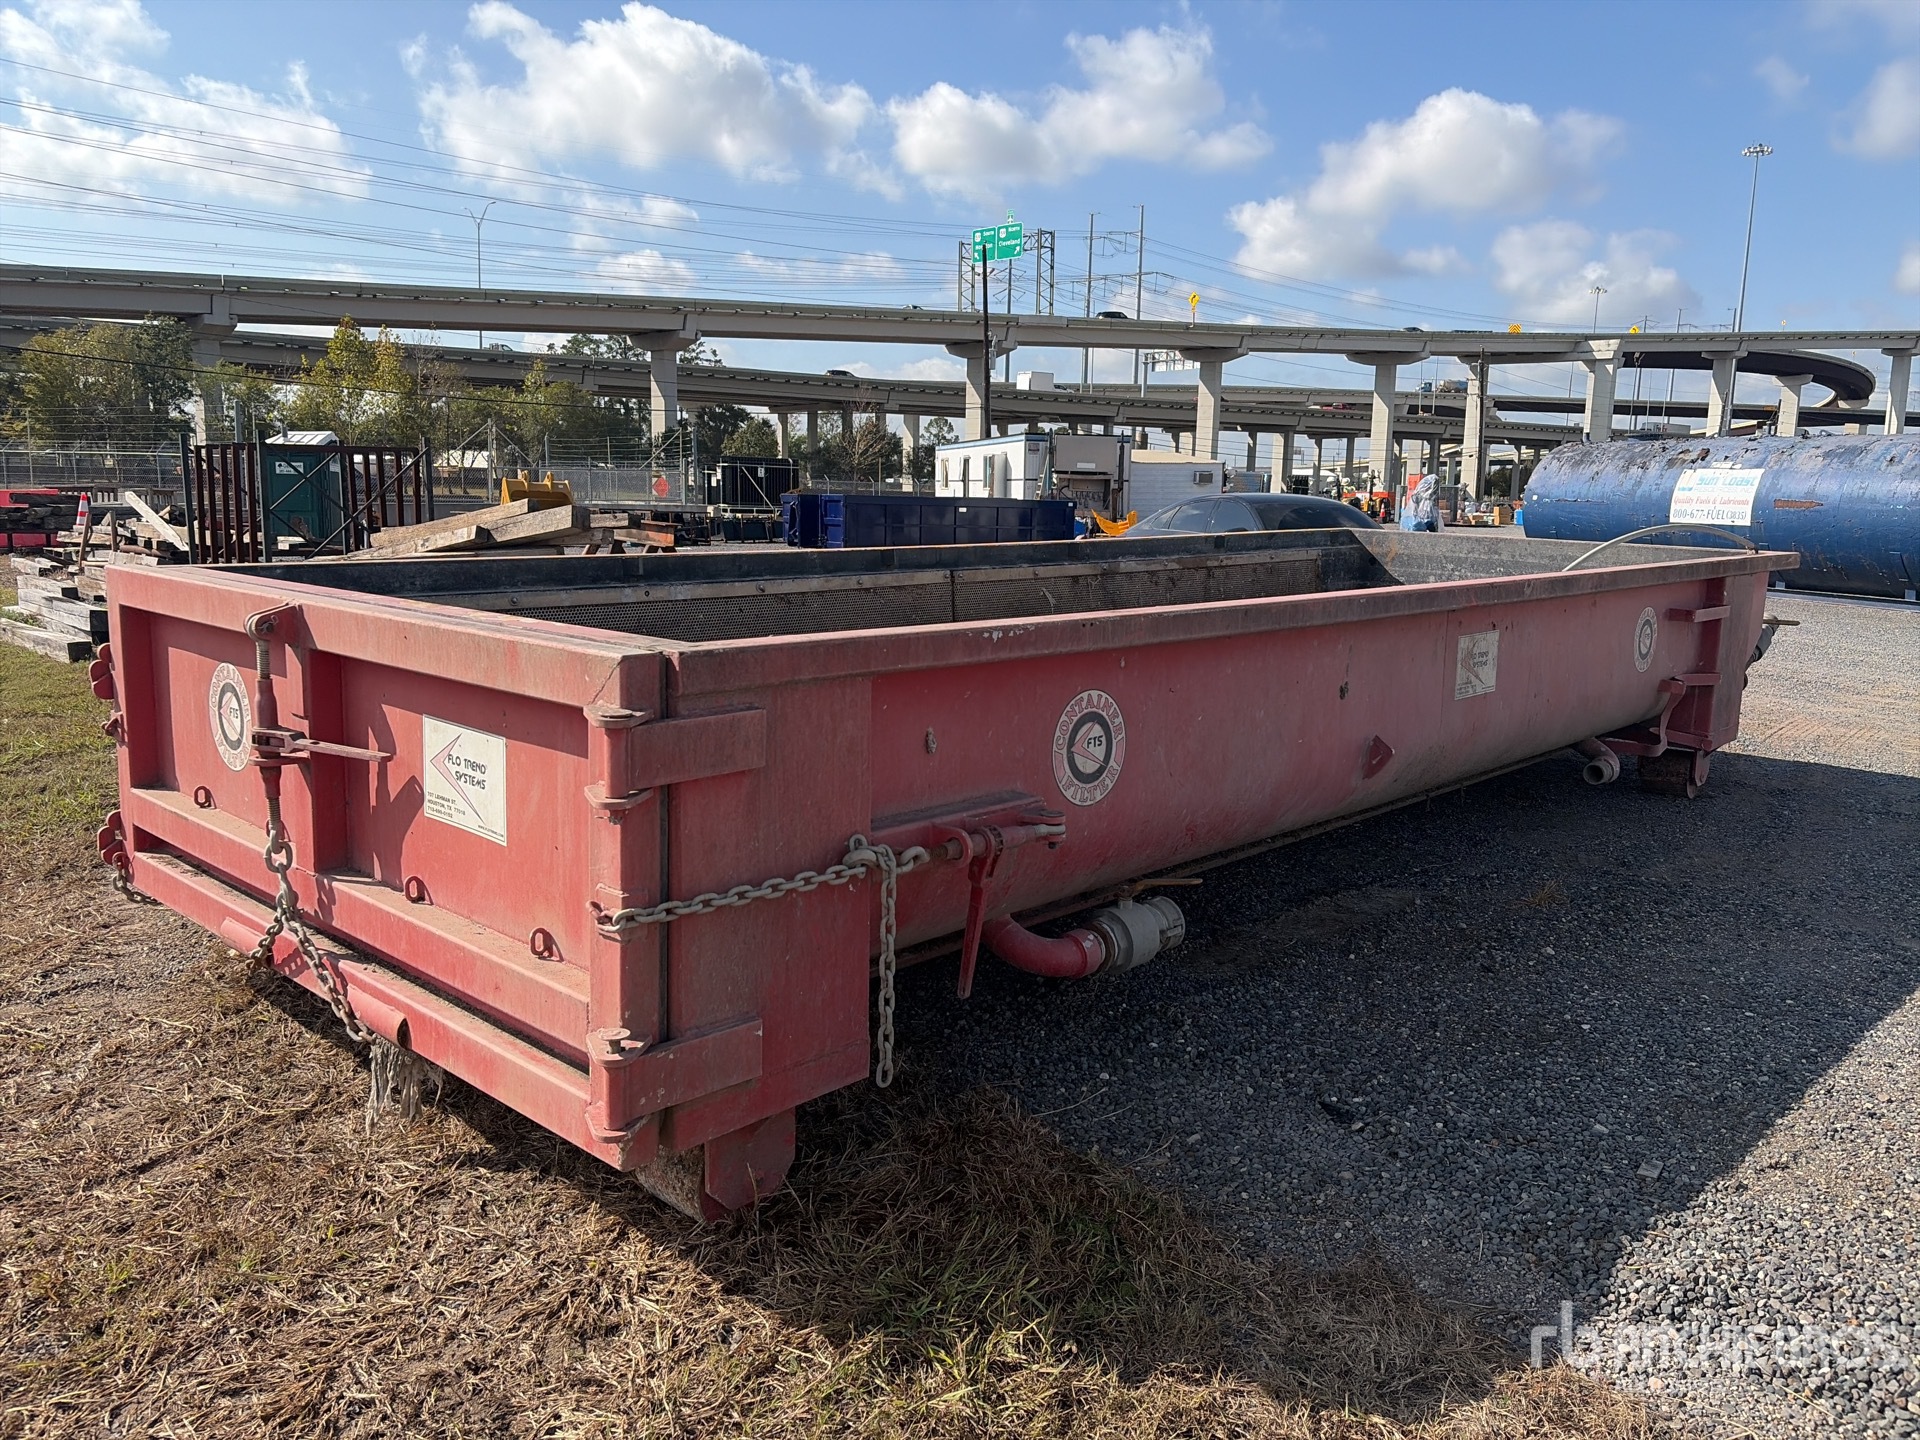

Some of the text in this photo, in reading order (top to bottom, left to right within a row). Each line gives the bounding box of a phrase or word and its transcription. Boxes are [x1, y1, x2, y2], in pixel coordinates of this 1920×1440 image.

[998, 238, 1020, 246] Cleveland
[1674, 496, 1750, 506] Quality Fuels & Lubricants
[229, 706, 240, 720] FTS
[1055, 692, 1124, 750] CONTAINER
[1086, 734, 1104, 749] FTS
[448, 753, 487, 775] FLO TREND
[454, 770, 486, 790] SYSTEMS
[1062, 765, 1119, 802] FILTER
